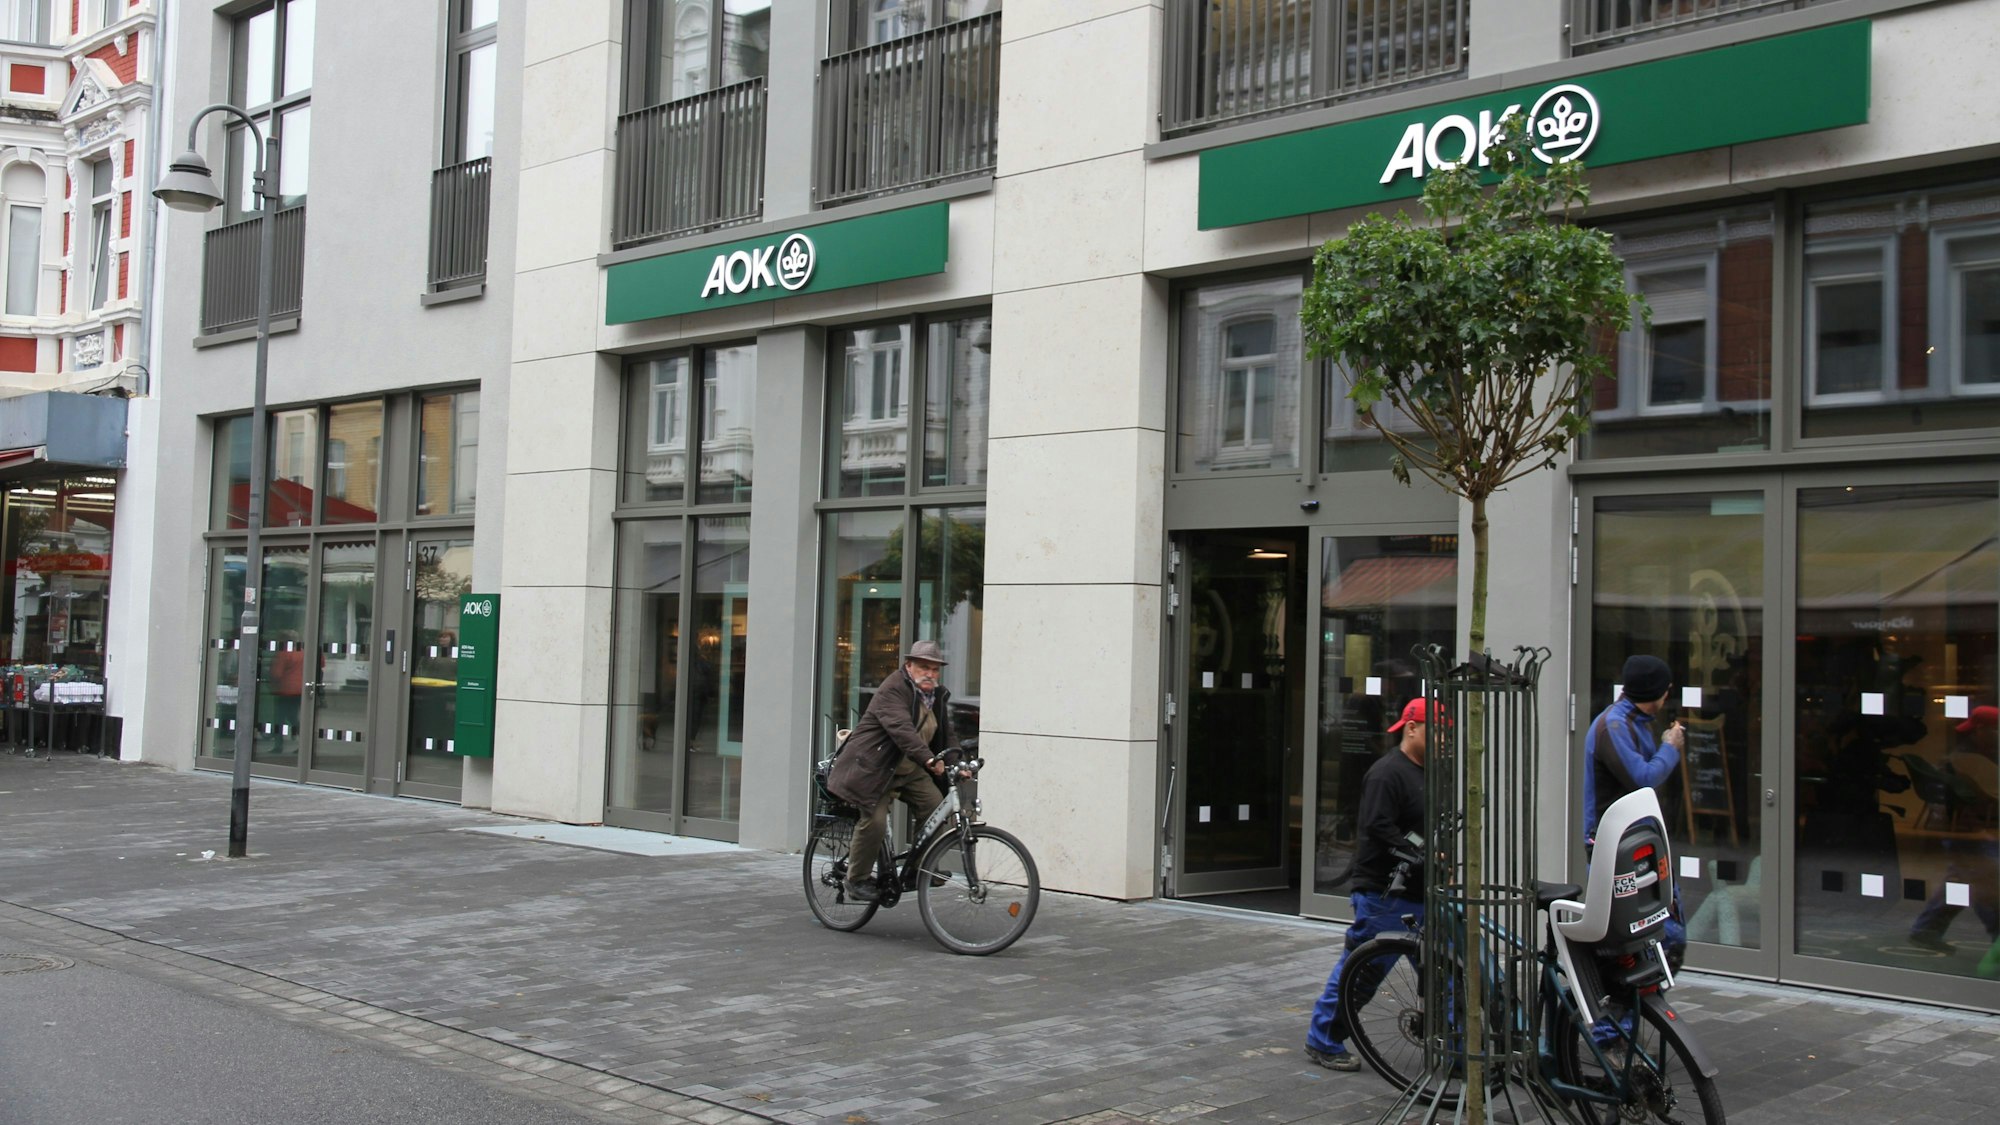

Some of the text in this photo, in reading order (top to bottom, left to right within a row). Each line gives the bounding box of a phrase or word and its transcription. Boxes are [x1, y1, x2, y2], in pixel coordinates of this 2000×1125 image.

[1379, 104, 1521, 184] AOK
[701, 246, 777, 298] AOK
[422, 546, 438, 566] 37
[463, 601, 483, 615] AOK
[1615, 876, 1635, 887] FCK
[1615, 883, 1636, 894] NZS
[1647, 910, 1667, 925] BONN
